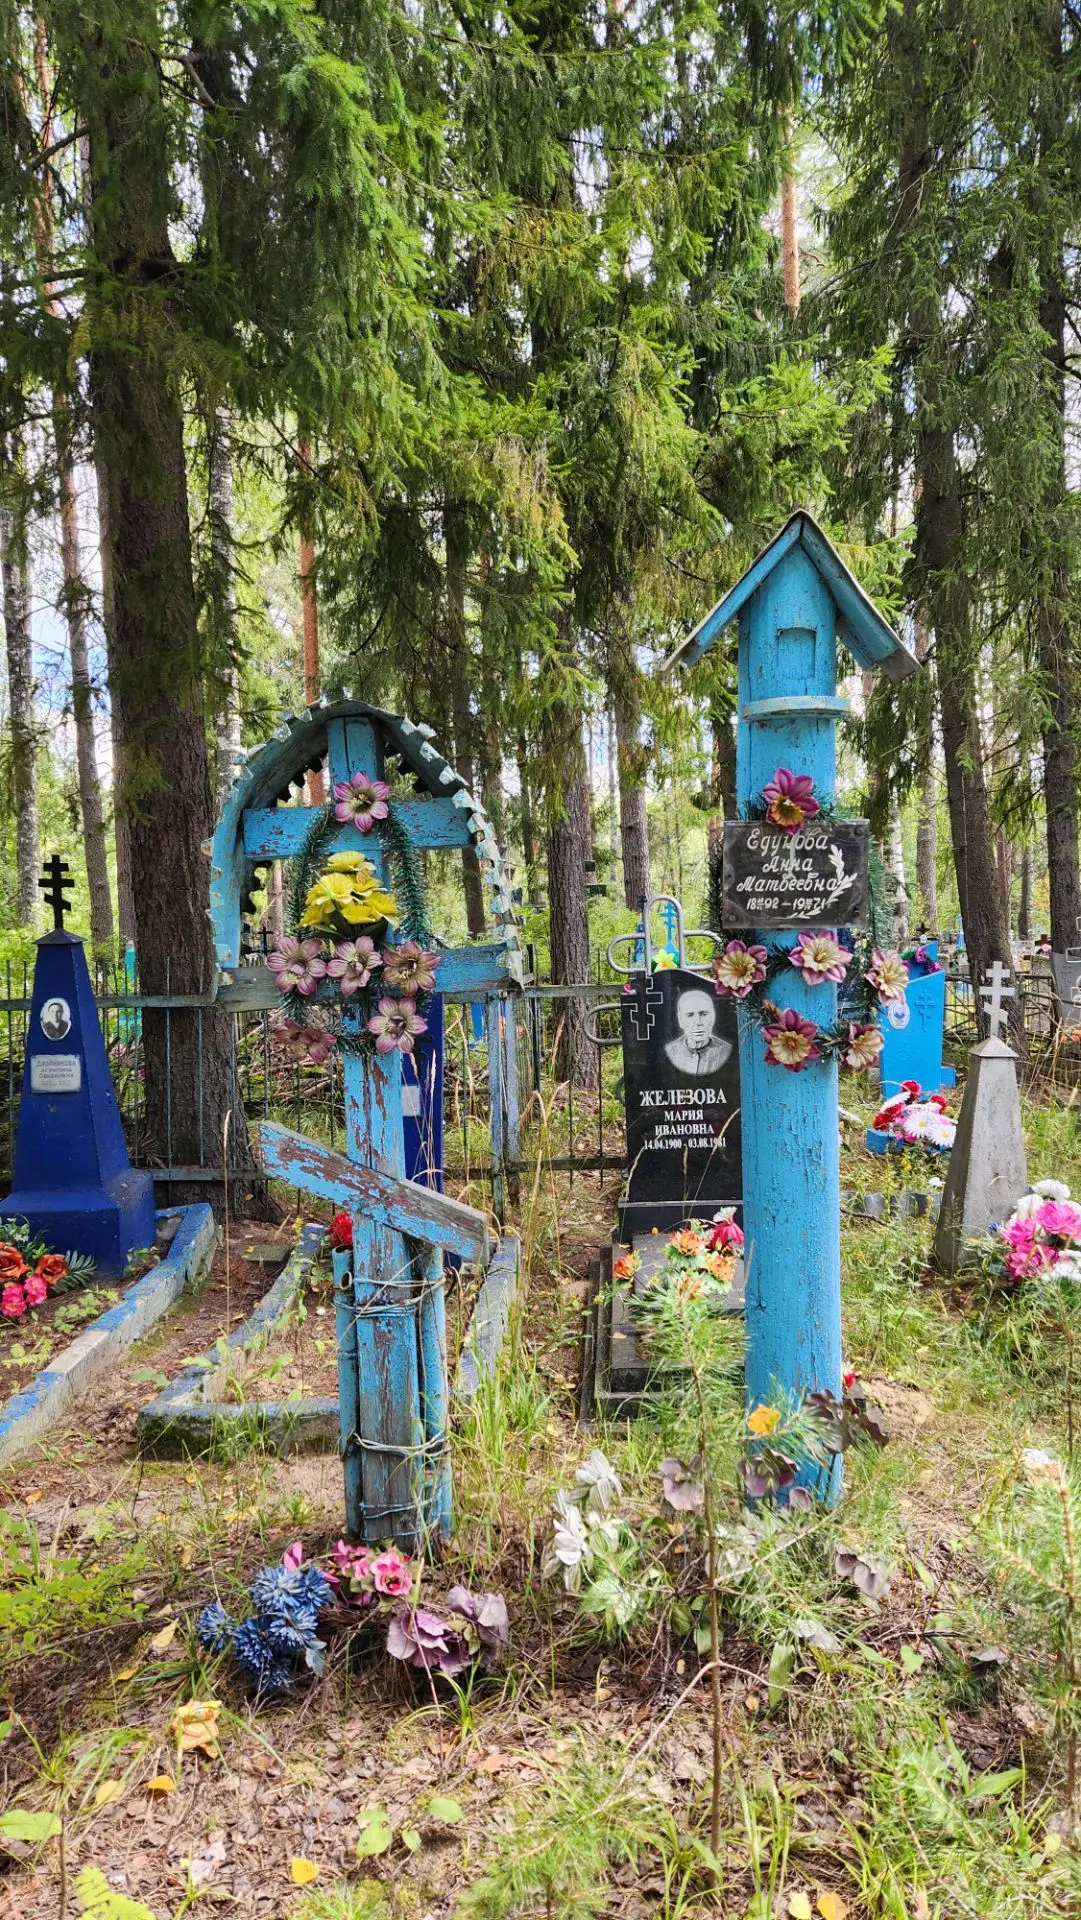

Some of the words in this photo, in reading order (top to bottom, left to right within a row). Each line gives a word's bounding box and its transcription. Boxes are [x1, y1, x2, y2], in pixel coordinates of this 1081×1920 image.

[762, 856, 814, 873] Анна
[736, 872, 838, 892] Матвеевна
[639, 1088, 728, 1106] ЖЕЛЕЗОВА
[664, 1110, 704, 1121] МАРИЯ
[655, 1124, 715, 1136] ИВАНОВНА
[644, 1138, 682, 1150] 14.04.1900
[688, 1137, 726, 1149] 03.08.1981
